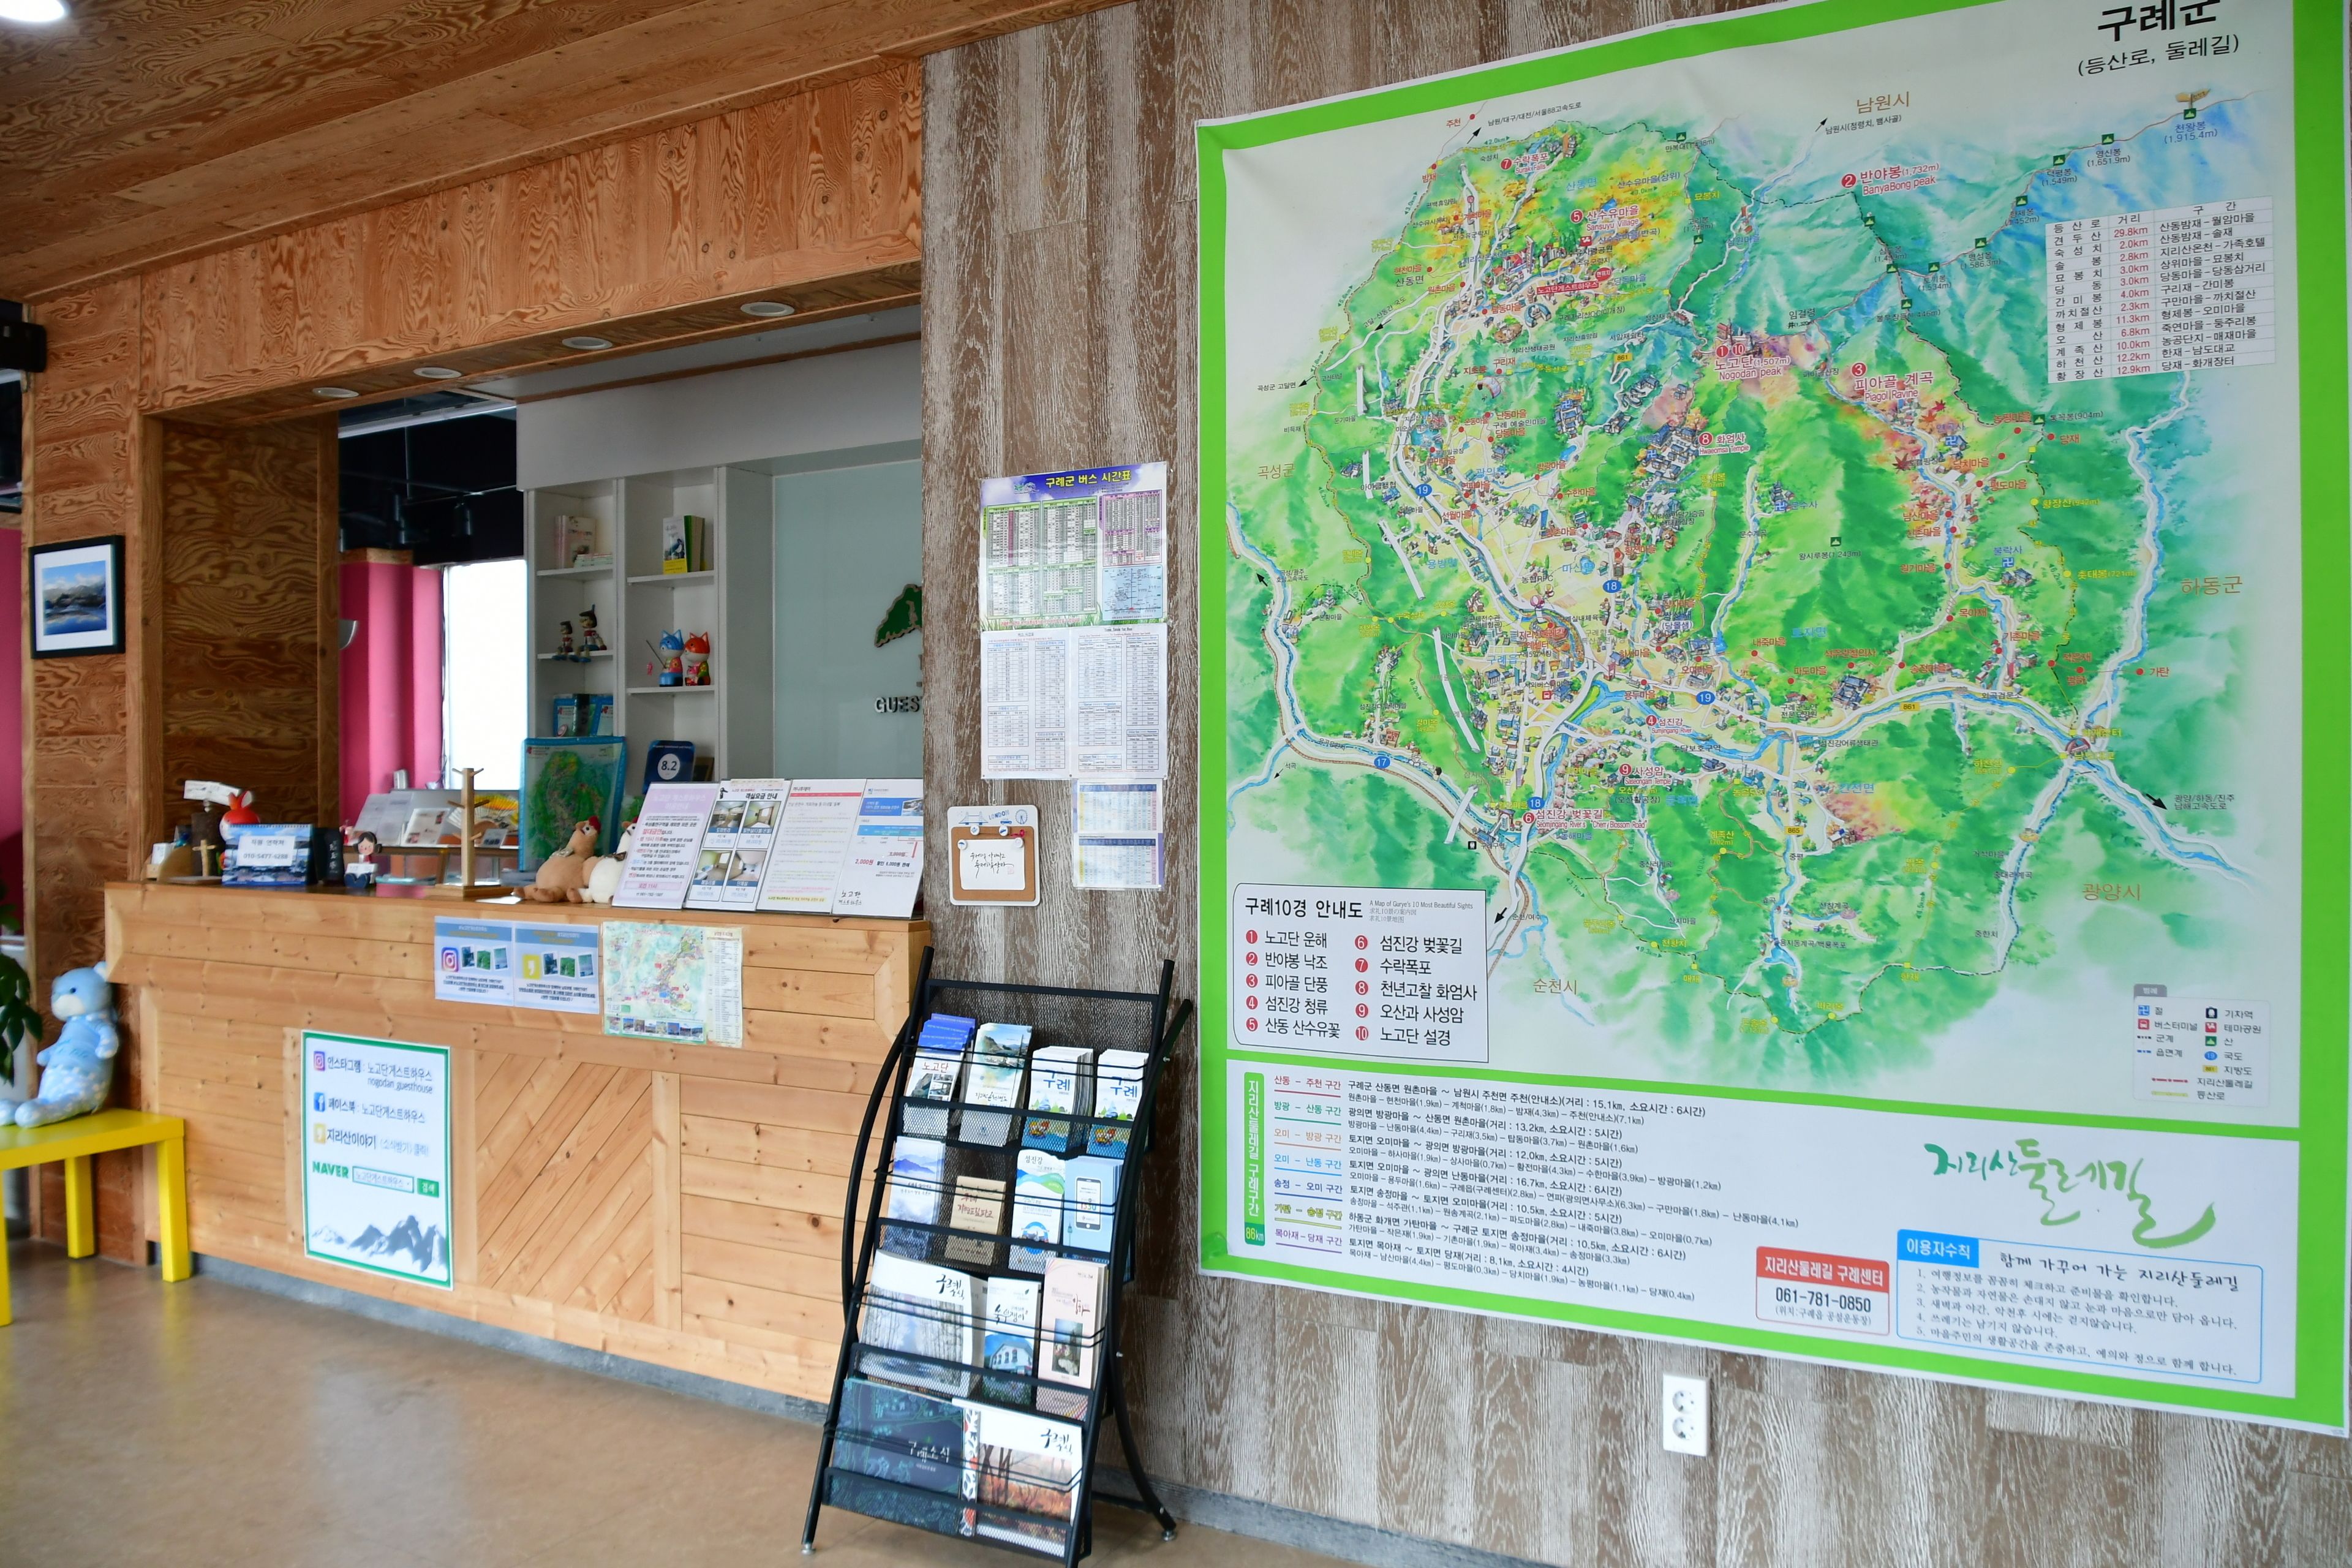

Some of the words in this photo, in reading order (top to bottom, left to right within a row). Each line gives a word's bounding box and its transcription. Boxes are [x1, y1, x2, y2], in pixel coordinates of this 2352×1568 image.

[2097, 0, 2220, 41] 구례군
[2078, 49, 2156, 77] (등산로,
[2165, 33, 2240, 61] 둘레길)
[1856, 91, 1911, 114] 남원시
[1446, 118, 1461, 127] 주천
[2176, 121, 2205, 134] 천왕봉
[1513, 153, 1549, 166] 수락폭포
[2096, 148, 2121, 157] 영신봉
[1860, 165, 1902, 184] 반야봉
[1863, 178, 1911, 195] BanyaBong
[1913, 175, 1937, 190] peak
[1587, 205, 1638, 221] 산수유마을
[2117, 213, 2141, 224] 거리
[1586, 221, 1615, 231] Sansuyu
[1617, 217, 1638, 228] Village
[2114, 227, 2147, 238] 29.8km
[2119, 239, 2148, 249] 2.0km
[2120, 252, 2148, 262] 2.8km
[2120, 264, 2149, 274] 3.0km
[2120, 276, 2149, 287] 3.0km
[2120, 289, 2149, 299] 4.0km
[2120, 302, 2149, 312] 2.3km
[2116, 314, 2149, 325] 11.3km
[2121, 327, 2150, 337] 6.8km
[2117, 340, 2150, 350] 10.0km
[1715, 357, 1753, 370] 노고단
[2117, 353, 2150, 363] 12.2km
[1719, 369, 1756, 380] Nogodan
[1760, 368, 1782, 378] peak
[2117, 365, 2150, 375] 12.9km
[1855, 375, 1897, 390] 피아골
[1906, 371, 1934, 385] 계곡
[1864, 391, 1888, 402] Piagol
[1892, 388, 1918, 399] Ravine
[1716, 432, 1746, 444] 화엄사
[2060, 434, 2080, 445] 당재
[1730, 444, 1750, 453] Temple
[1257, 462, 1295, 480] 곡성군
[1046, 476, 1074, 488] 구례군
[1079, 474, 1098, 484] 버스
[1101, 470, 1131, 482] 시간표
[1605, 581, 1617, 591] 18
[2180, 576, 2243, 596] 하동군
[2149, 667, 2169, 677] 가탄
[875, 696, 922, 713] GUES
[1698, 693, 1712, 703] 19
[1659, 717, 1683, 726] 섬진강
[662, 761, 677, 771] 8.2
[1635, 766, 1664, 775] 사성암
[989, 810, 1009, 820] LONDON
[1536, 809, 1566, 819] 섬진강
[1572, 809, 1603, 819] 벚꽃길
[2082, 883, 2142, 902] 광양시
[1245, 897, 1307, 918] 구례10경
[1315, 900, 1363, 919] 안내도
[1265, 929, 1300, 947] 노고단
[1303, 932, 1327, 948] 운해
[1380, 935, 1418, 953] 섬진강
[1423, 937, 1463, 954] 벚꽃길
[1265, 951, 1300, 969] 반야봉
[1304, 954, 1328, 970] 낙조
[1380, 957, 1431, 975] 수락폭포
[1265, 973, 1300, 991] 피아골
[1304, 977, 1329, 993] 단풍
[1532, 979, 1578, 995] 순천시
[1381, 980, 1433, 999] 천년고찰
[1436, 982, 1477, 1001] 화엄사
[1265, 995, 1300, 1013] 섬진강
[1304, 999, 1329, 1015] 청류
[1380, 1005, 1419, 1022] 오산과
[1423, 1006, 1464, 1023] 사성암
[2225, 1010, 2253, 1019] 기차역
[1265, 1018, 1289, 1035] 산동
[1292, 1020, 1341, 1038] 산수유꽃
[2154, 1021, 2198, 1031] 버스터미널
[2224, 1024, 2261, 1034] 테마공원
[1381, 1027, 1419, 1044] 노고단
[1423, 1030, 1451, 1046] 설경
[2224, 1052, 2242, 1060] 국도
[327, 1056, 361, 1073] 인스타그램
[367, 1062, 432, 1081] 노고단게스트하우스
[922, 1061, 949, 1073] 노고단
[2224, 1066, 2252, 1076] 지방도
[1043, 1069, 1070, 1091] 구례
[1110, 1076, 1137, 1098] 구례
[1274, 1076, 1290, 1085] 산동
[1306, 1078, 1322, 1089] 주천
[1325, 1079, 1341, 1090] 구간
[1348, 1080, 1372, 1091] 구례군
[1375, 1082, 1400, 1093] 산동면
[1403, 1084, 1438, 1096] 원촌마을
[2197, 1091, 2225, 1100] 등산로
[328, 1097, 355, 1114] 페이스북
[362, 1104, 425, 1123] 노고단게스트하우스
[1274, 1101, 1290, 1111] 방광
[1248, 1080, 1260, 1160] 지리산둘레길
[327, 1128, 376, 1149] 지리산이야기
[1274, 1128, 1289, 1139] 오미
[1348, 1134, 1373, 1145] 토지면
[1376, 1135, 1410, 1148] 오미마을
[1025, 1155, 1042, 1164] 섬진강
[312, 1161, 349, 1178] NAVER
[422, 1182, 435, 1194] 검색
[1248, 1165, 1260, 1216] 구례구간
[1274, 1178, 1290, 1189] 송정
[1924, 1138, 2216, 1248] 지리산둘레길
[1245, 1227, 1264, 1242] 86km
[1275, 1229, 1299, 1241] 목아재
[1906, 1237, 1970, 1259] 이용자수칙
[1765, 1256, 1833, 1279] 지리산둘레길
[1837, 1265, 1883, 1286] 구례센터
[2000, 1253, 2032, 1268] 함께
[2040, 1259, 2087, 1275] 가꾸어
[2096, 1264, 2128, 1280] 가는
[2138, 1268, 2239, 1292] 지리산둘레길
[936, 1274, 962, 1294] 구례
[1776, 1287, 1872, 1313] 061-781-0850
[1041, 1428, 1069, 1449] 구례
